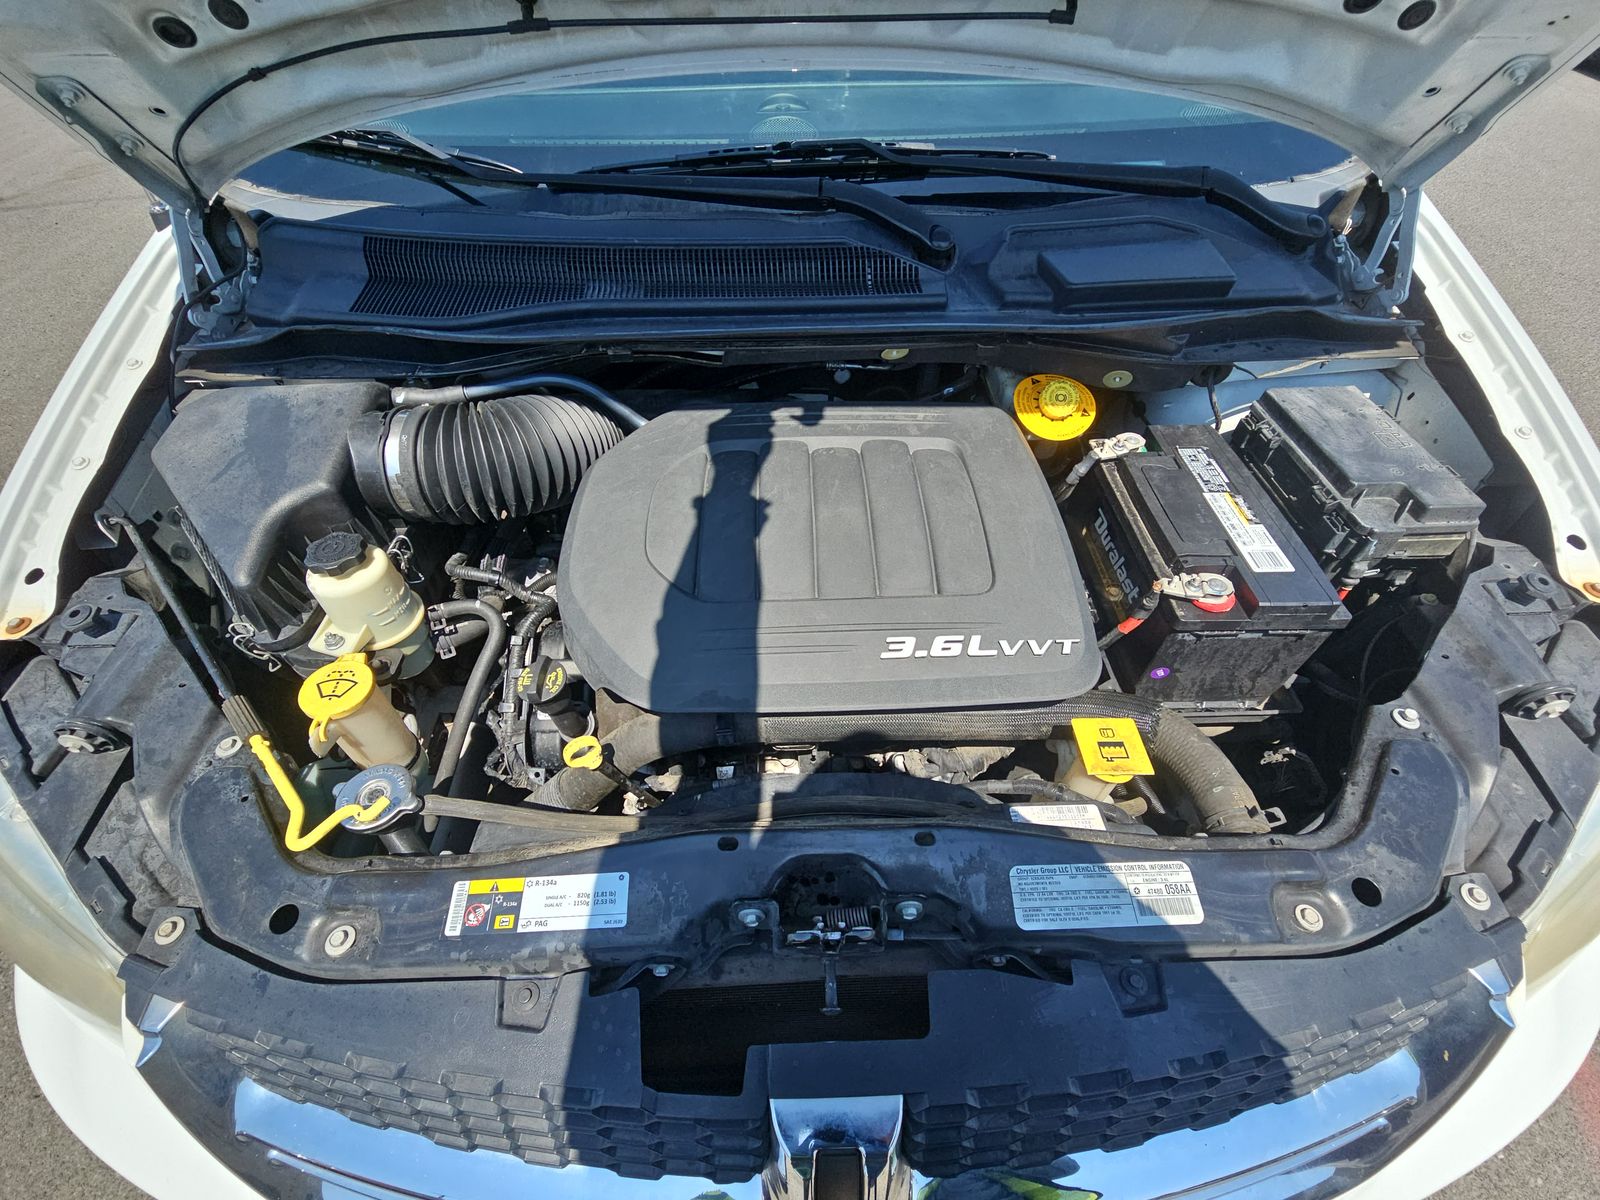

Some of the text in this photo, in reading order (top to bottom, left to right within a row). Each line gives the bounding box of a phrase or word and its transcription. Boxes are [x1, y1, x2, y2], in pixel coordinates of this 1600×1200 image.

[1092, 508, 1141, 604] Duralast
[880, 635, 1081, 659] 3.6L VVT
[1016, 865, 1070, 877] Chrysler Group LLC
[1074, 863, 1185, 873] VEHICLE EMISSION CONTROL INFORMATION
[534, 879, 557, 887] R-134a
[1164, 883, 1191, 895] 058AA
